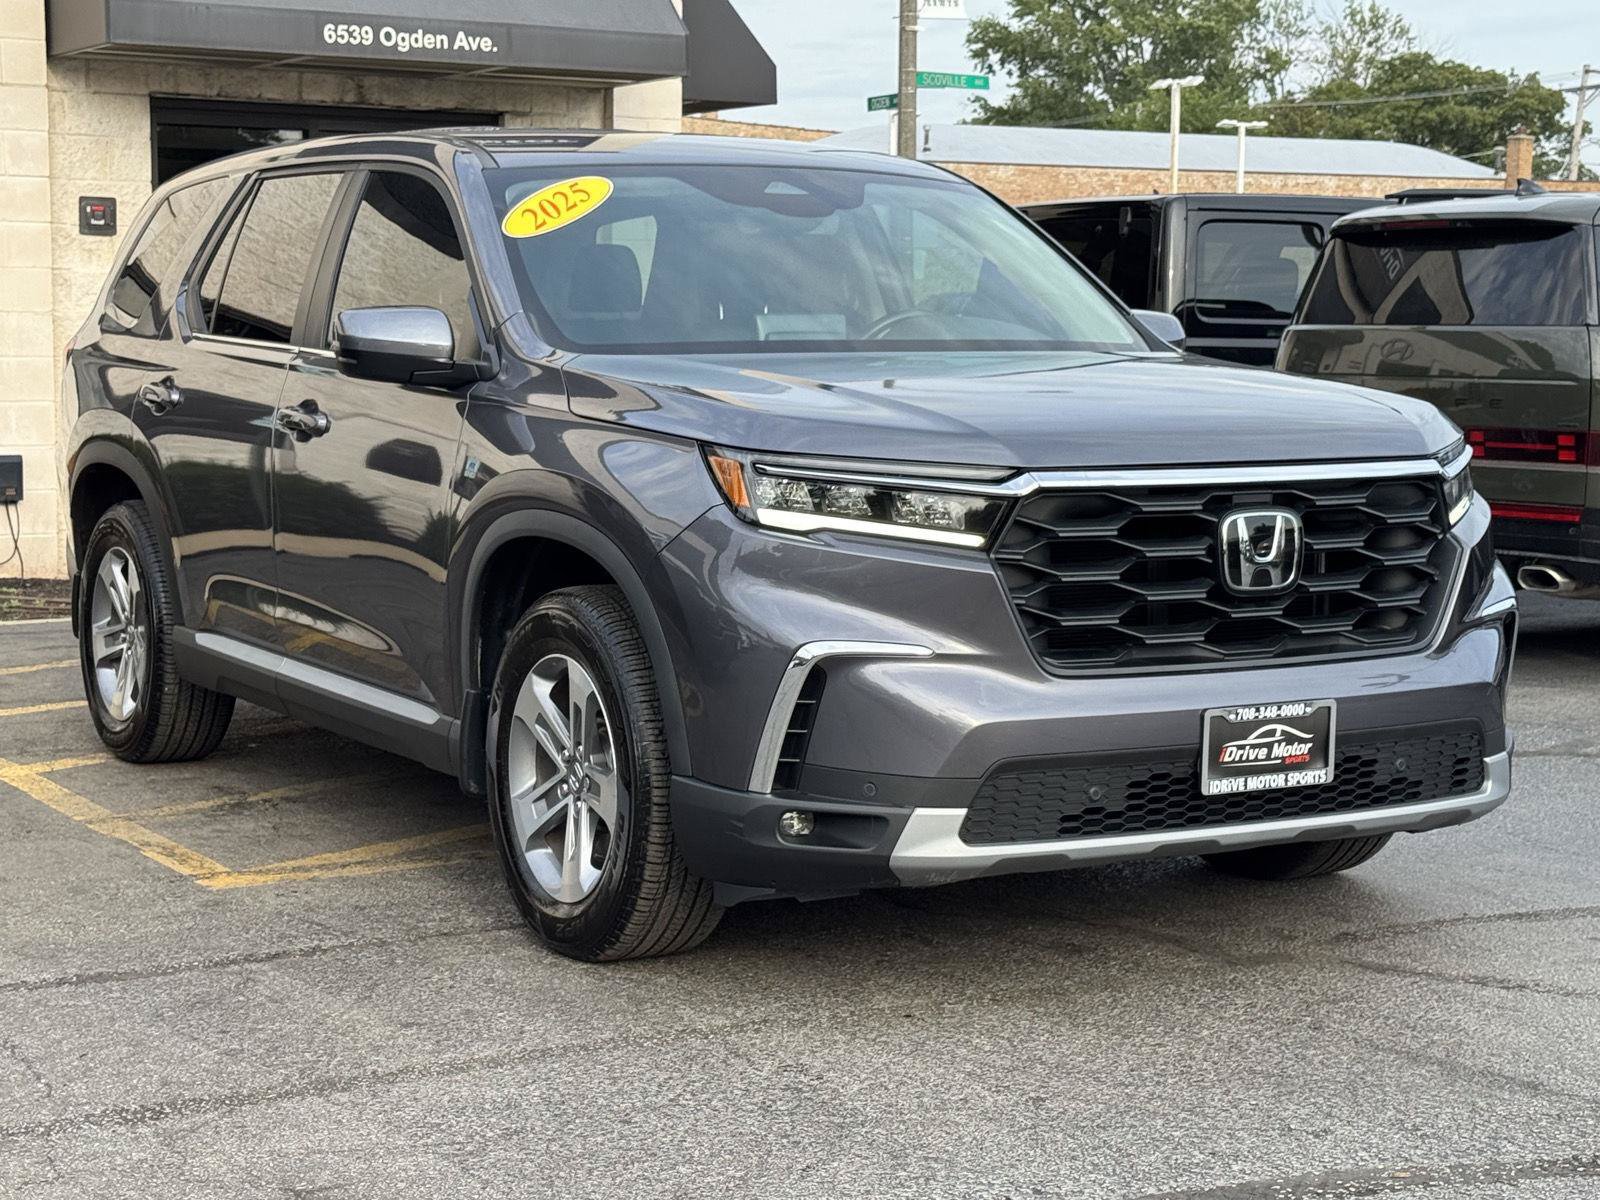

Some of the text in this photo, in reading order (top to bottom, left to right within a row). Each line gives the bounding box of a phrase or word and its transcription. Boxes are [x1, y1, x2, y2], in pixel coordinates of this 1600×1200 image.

[323, 23, 498, 53] 6539 Ogden Ave.
[922, 74, 967, 87] SCOVILLE
[521, 182, 590, 230] 2025
[1236, 703, 1305, 721] 708-348-0000
[1270, 742, 1313, 759] Motor
[1285, 755, 1310, 764] SPORTS
[1246, 774, 1286, 790] MOTOR
[1287, 769, 1327, 786] SPORTS
